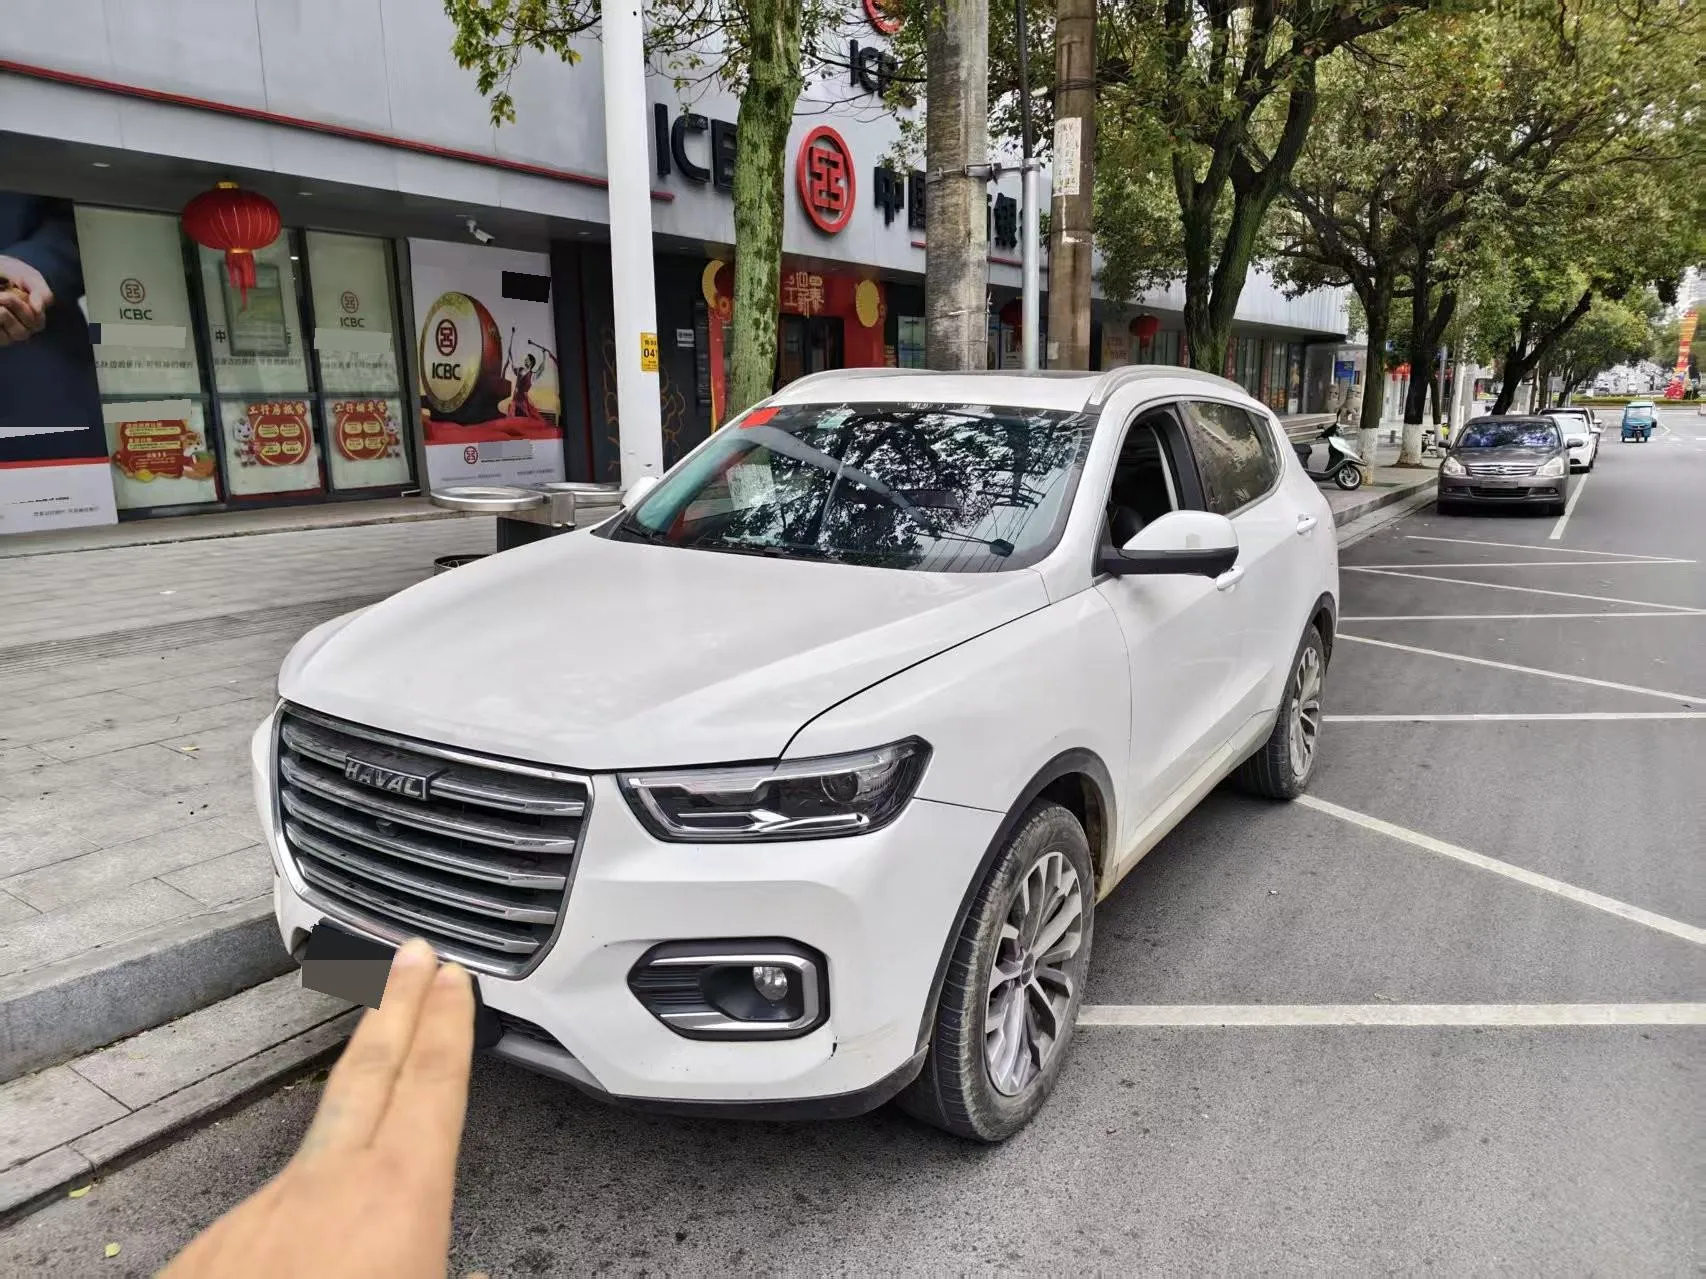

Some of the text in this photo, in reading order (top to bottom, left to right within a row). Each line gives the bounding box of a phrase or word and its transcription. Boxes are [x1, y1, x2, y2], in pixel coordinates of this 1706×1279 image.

[654, 102, 739, 188] ICB
[119, 307, 153, 321] ICBC
[340, 316, 366, 329] ICBC
[431, 362, 461, 382] ICBC
[344, 759, 422, 797] HAVAL
